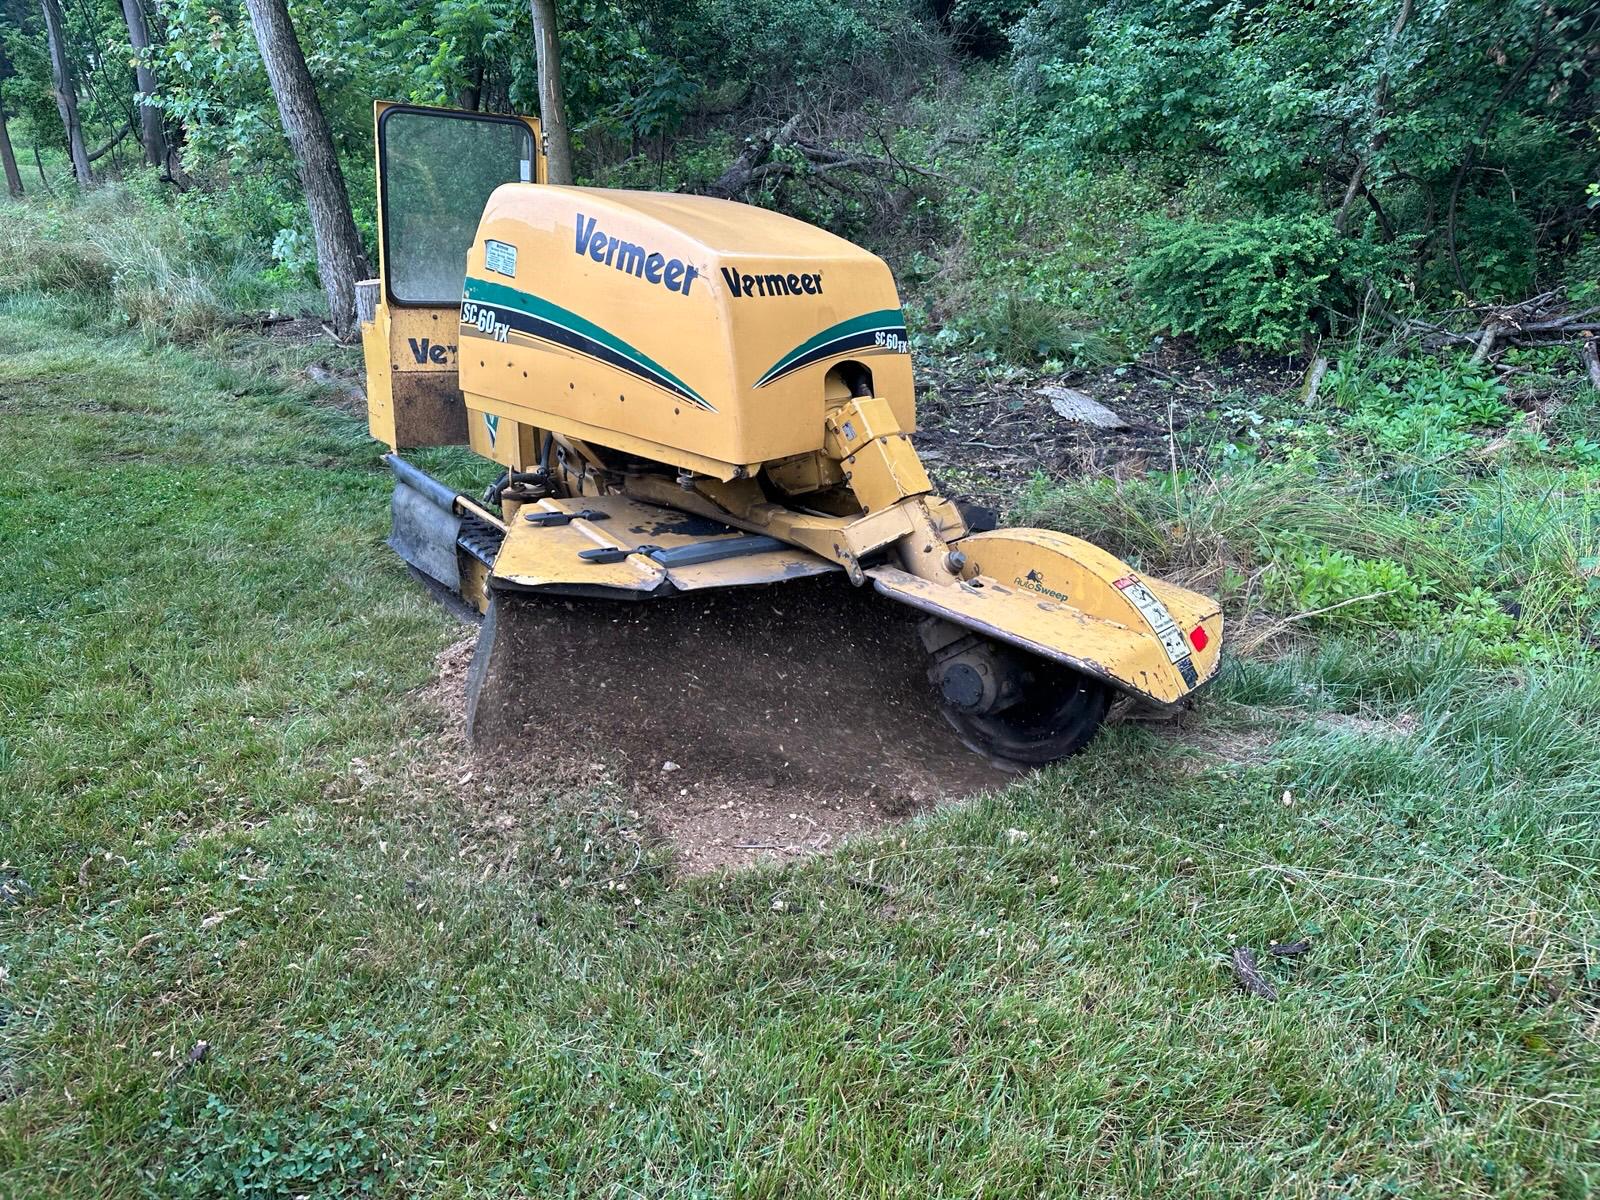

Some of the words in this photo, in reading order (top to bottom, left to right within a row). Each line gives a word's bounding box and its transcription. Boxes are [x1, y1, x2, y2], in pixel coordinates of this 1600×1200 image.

[575, 213, 699, 297] Vermeer
[721, 267, 824, 298] Vermeer
[1013, 577, 1069, 602] AutoSweep
